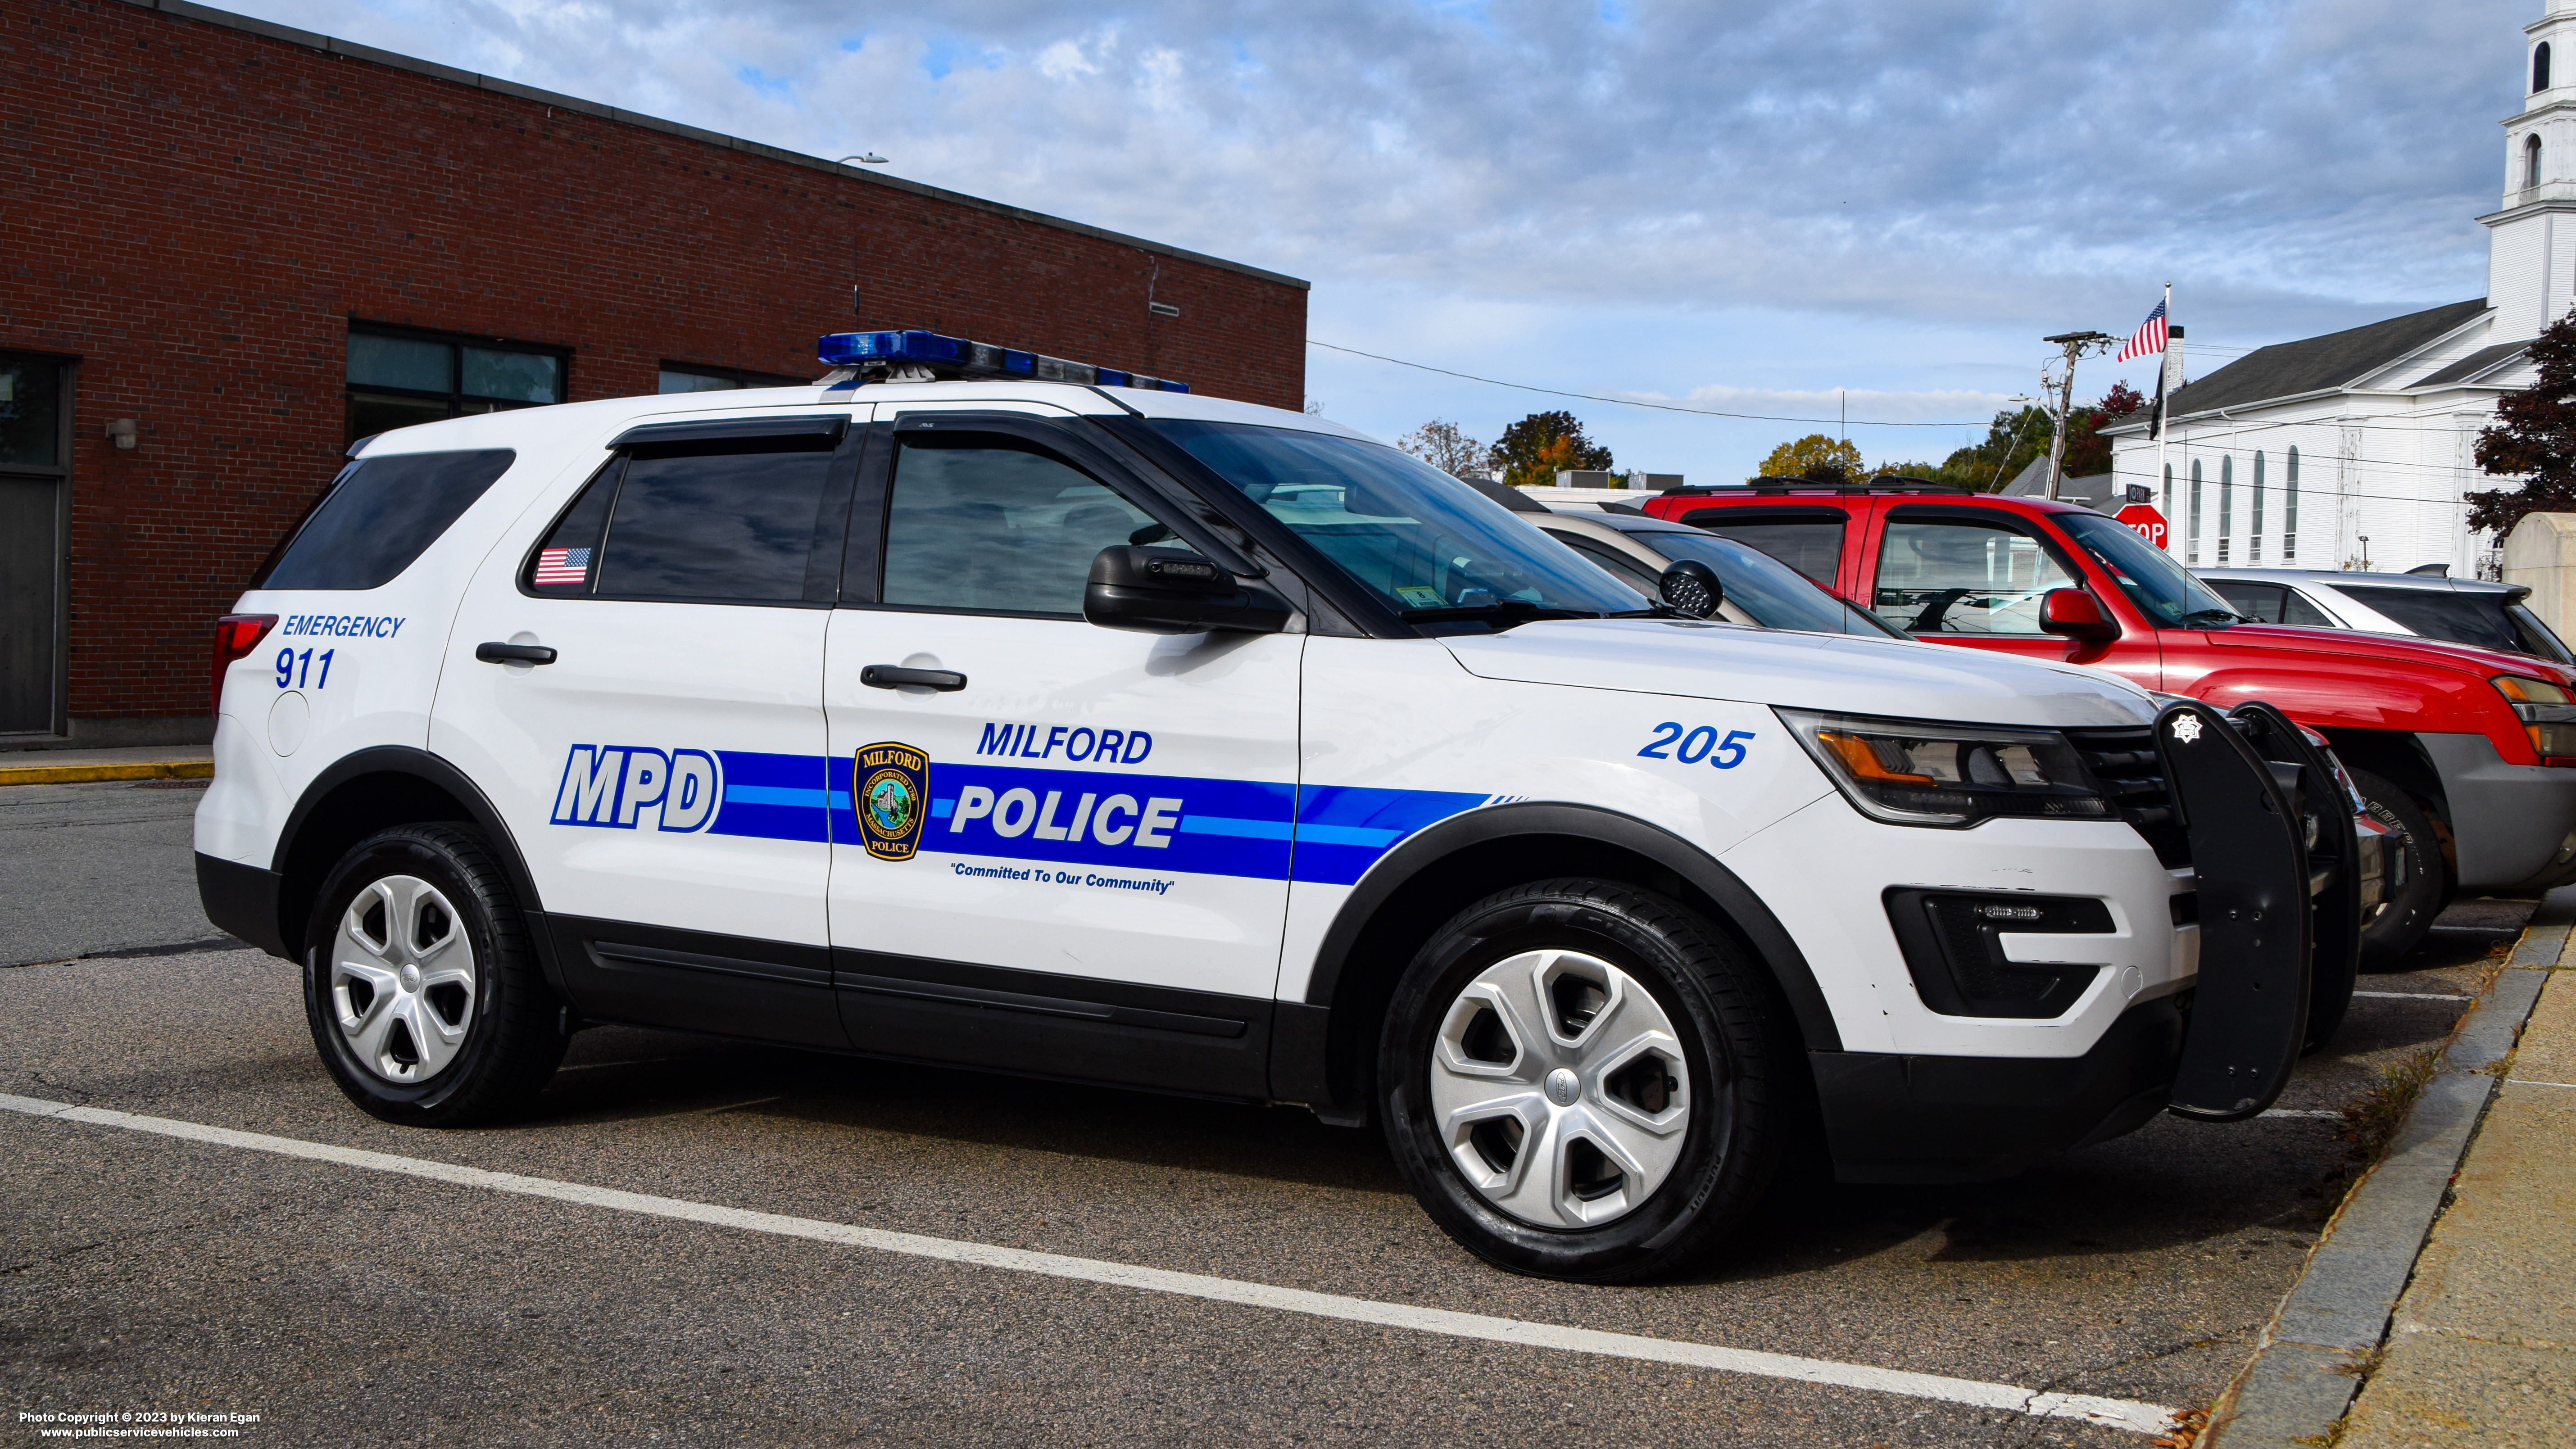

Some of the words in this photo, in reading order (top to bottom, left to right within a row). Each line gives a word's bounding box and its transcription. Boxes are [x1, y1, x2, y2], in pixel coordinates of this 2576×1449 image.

[283, 615, 405, 638] EMERGENCY
[276, 648, 335, 689] 911
[863, 750, 921, 771] MILFORD
[977, 722, 1152, 764] MILFORD
[1637, 721, 1756, 769] 205
[550, 743, 718, 833] MPD
[865, 771, 909, 797] INCORPORATED
[907, 786, 916, 801] 1780
[866, 813, 914, 837] MASSACHUSETTS
[950, 785, 1183, 849] POLICE
[871, 841, 909, 853] POLICE
[951, 862, 1030, 881] "Committed
[1034, 869, 1051, 883] To
[1056, 871, 1082, 885] Our
[1086, 873, 1175, 895] Community"
[1690, 1154, 1722, 1214] PURSUIT
